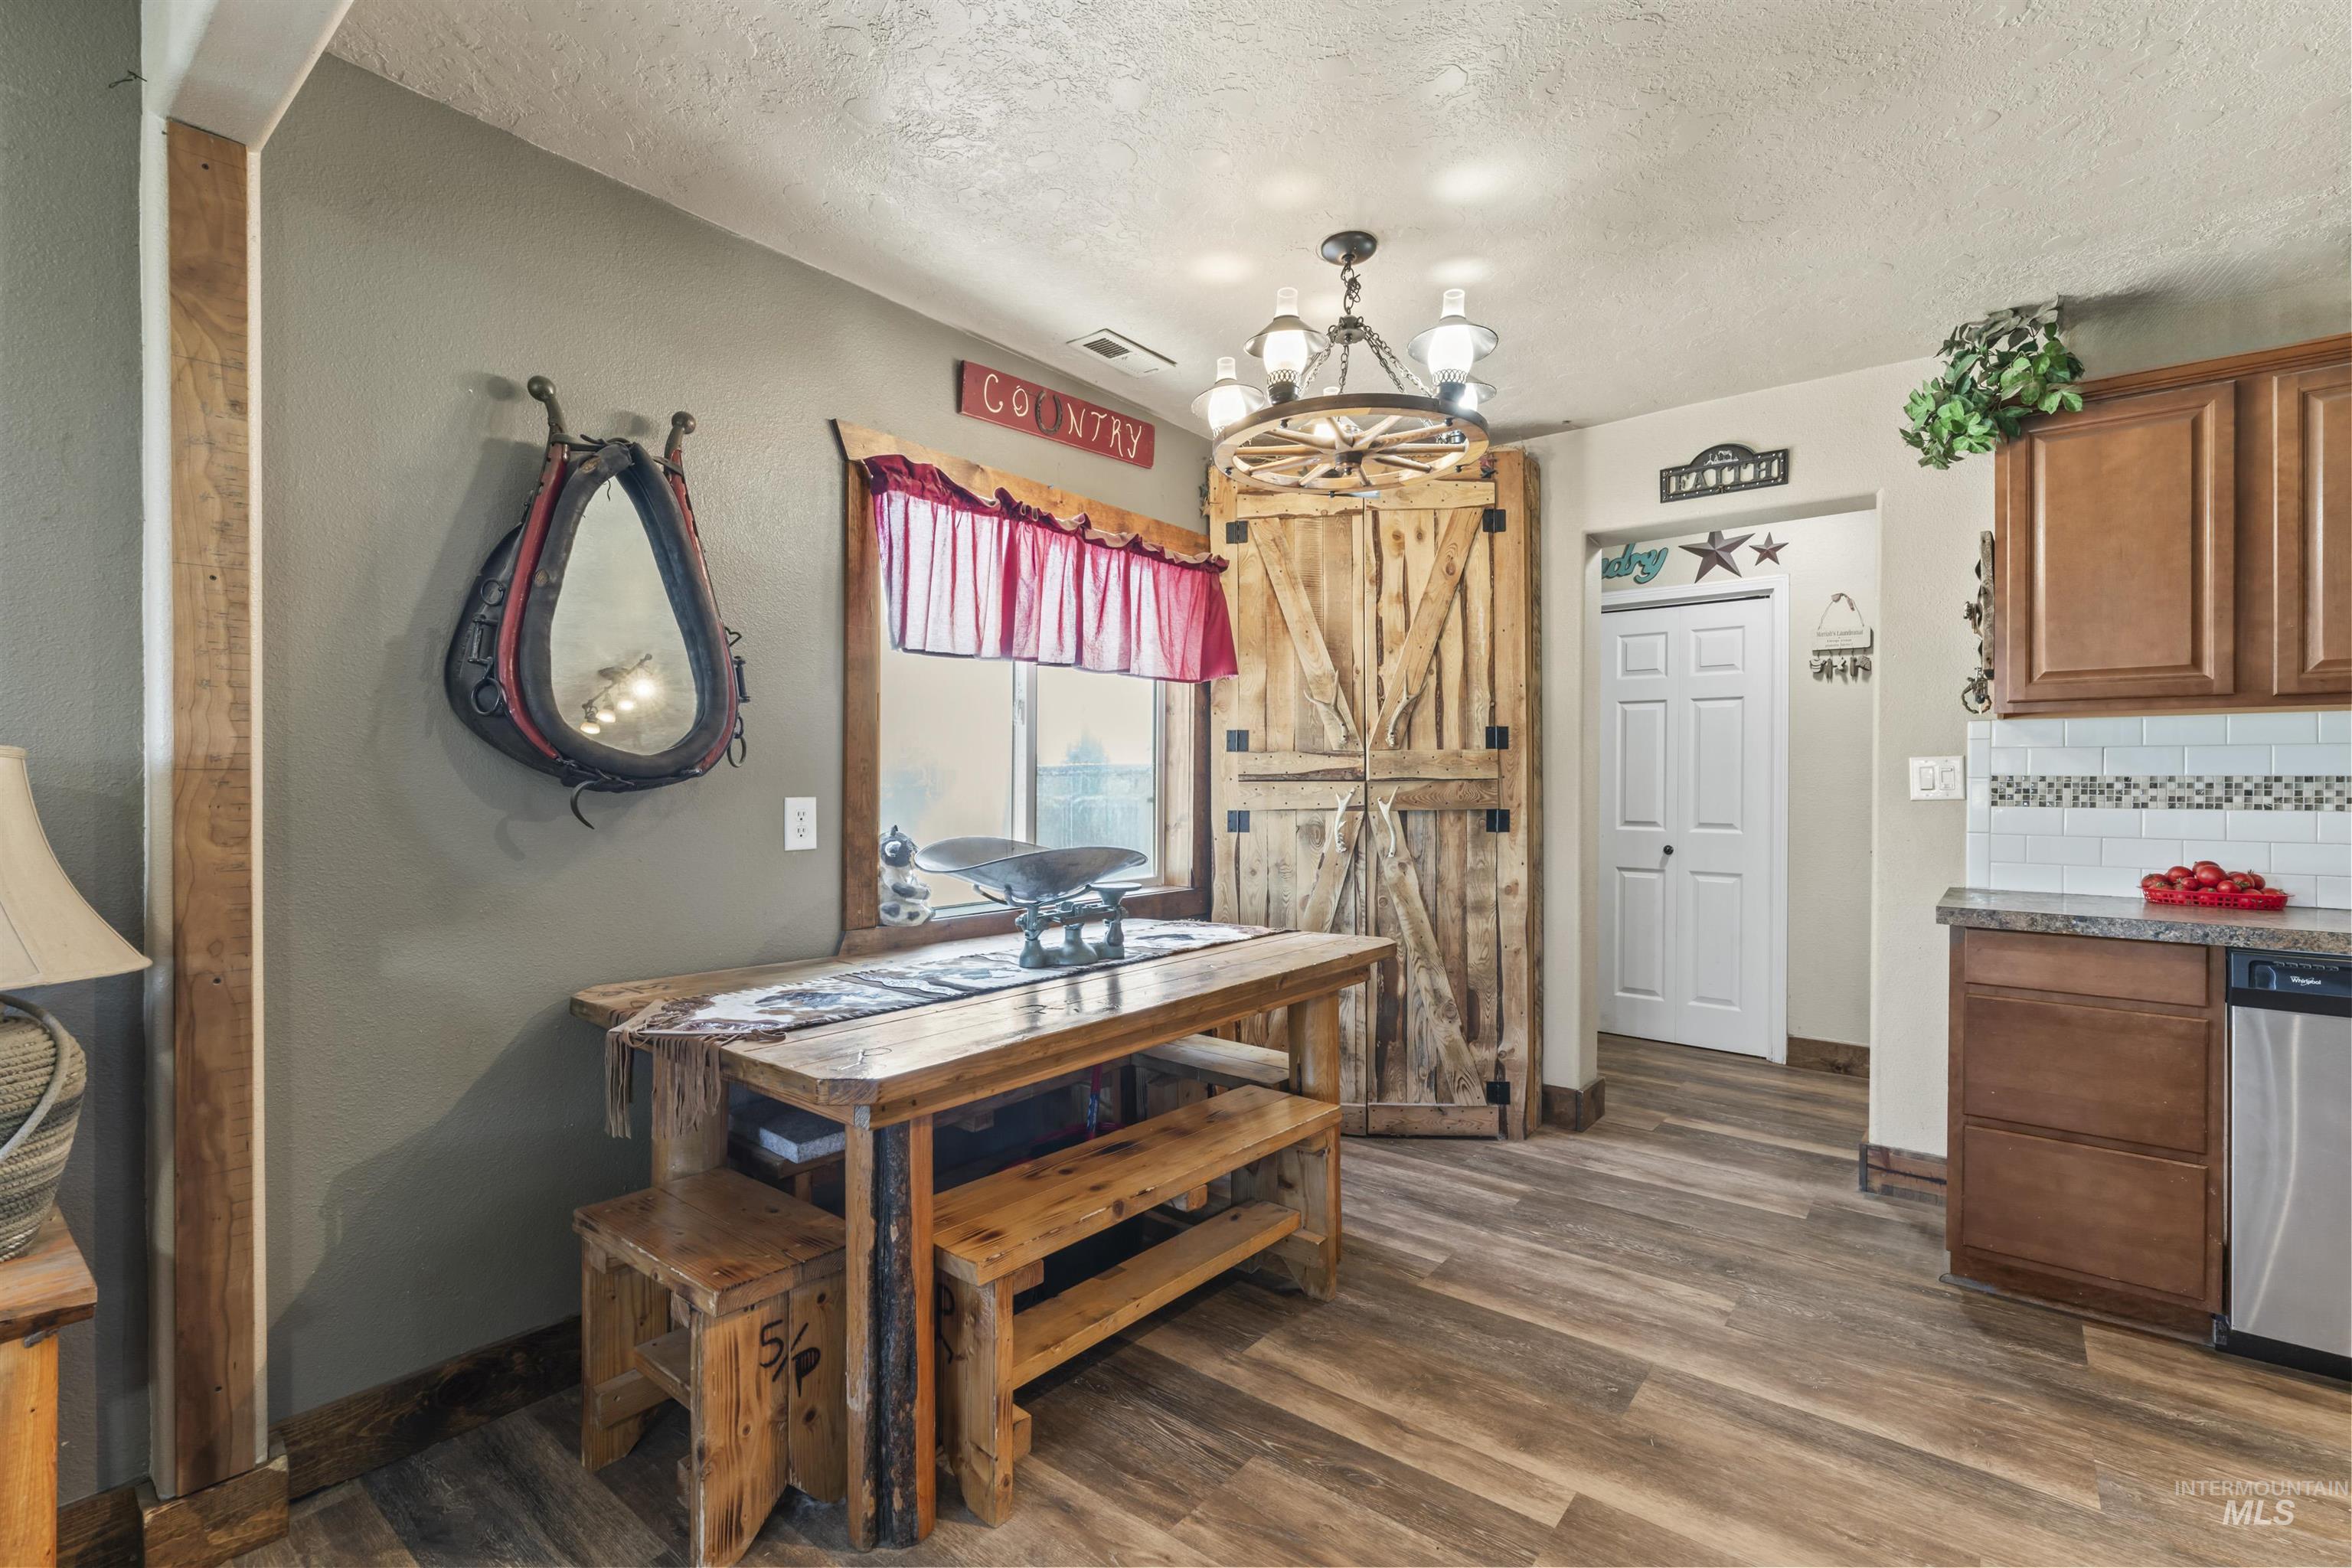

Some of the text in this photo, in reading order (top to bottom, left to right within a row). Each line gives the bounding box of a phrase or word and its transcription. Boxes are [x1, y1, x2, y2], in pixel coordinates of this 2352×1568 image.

[984, 373, 1142, 459] COUNTRY
[1674, 459, 1773, 494] FAITH
[2290, 975, 2321, 986] Whirlpool
